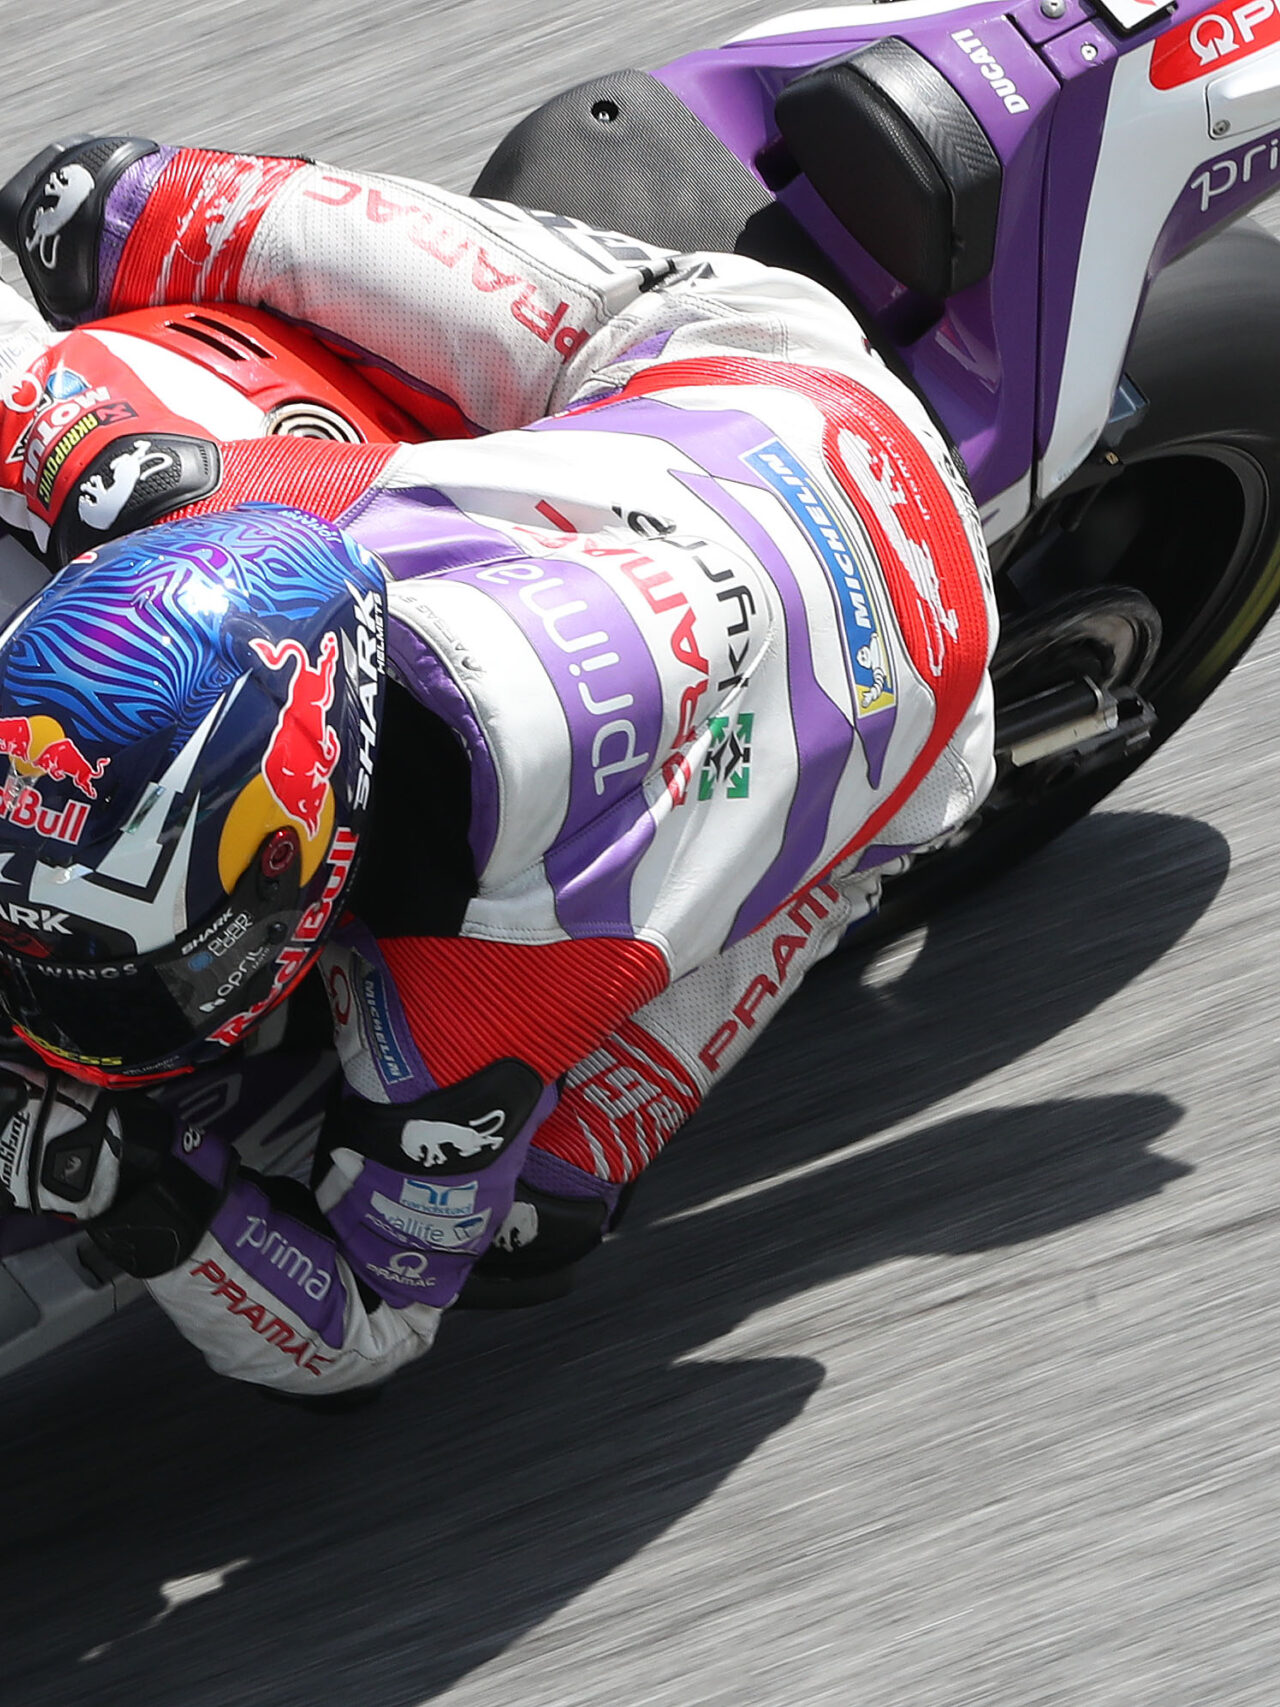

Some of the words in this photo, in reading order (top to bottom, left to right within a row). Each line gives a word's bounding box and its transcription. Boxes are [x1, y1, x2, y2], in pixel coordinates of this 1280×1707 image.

[951, 28, 1030, 115] DUCATI
[24, 386, 111, 485] MOTUL
[758, 453, 871, 629] MICHELIN
[376, 591, 384, 676] HELMETS
[353, 587, 379, 812] SHARK
[476, 563, 649, 796] prima
[16, 790, 89, 844] Bull
[37, 962, 138, 980] WINGS
[181, 907, 233, 956] SHARK
[364, 979, 406, 1081] MICHELIN
[237, 1214, 331, 1302] prima
[365, 1262, 437, 1287] PRAMAC
[190, 1258, 340, 1378] PRAMAC
